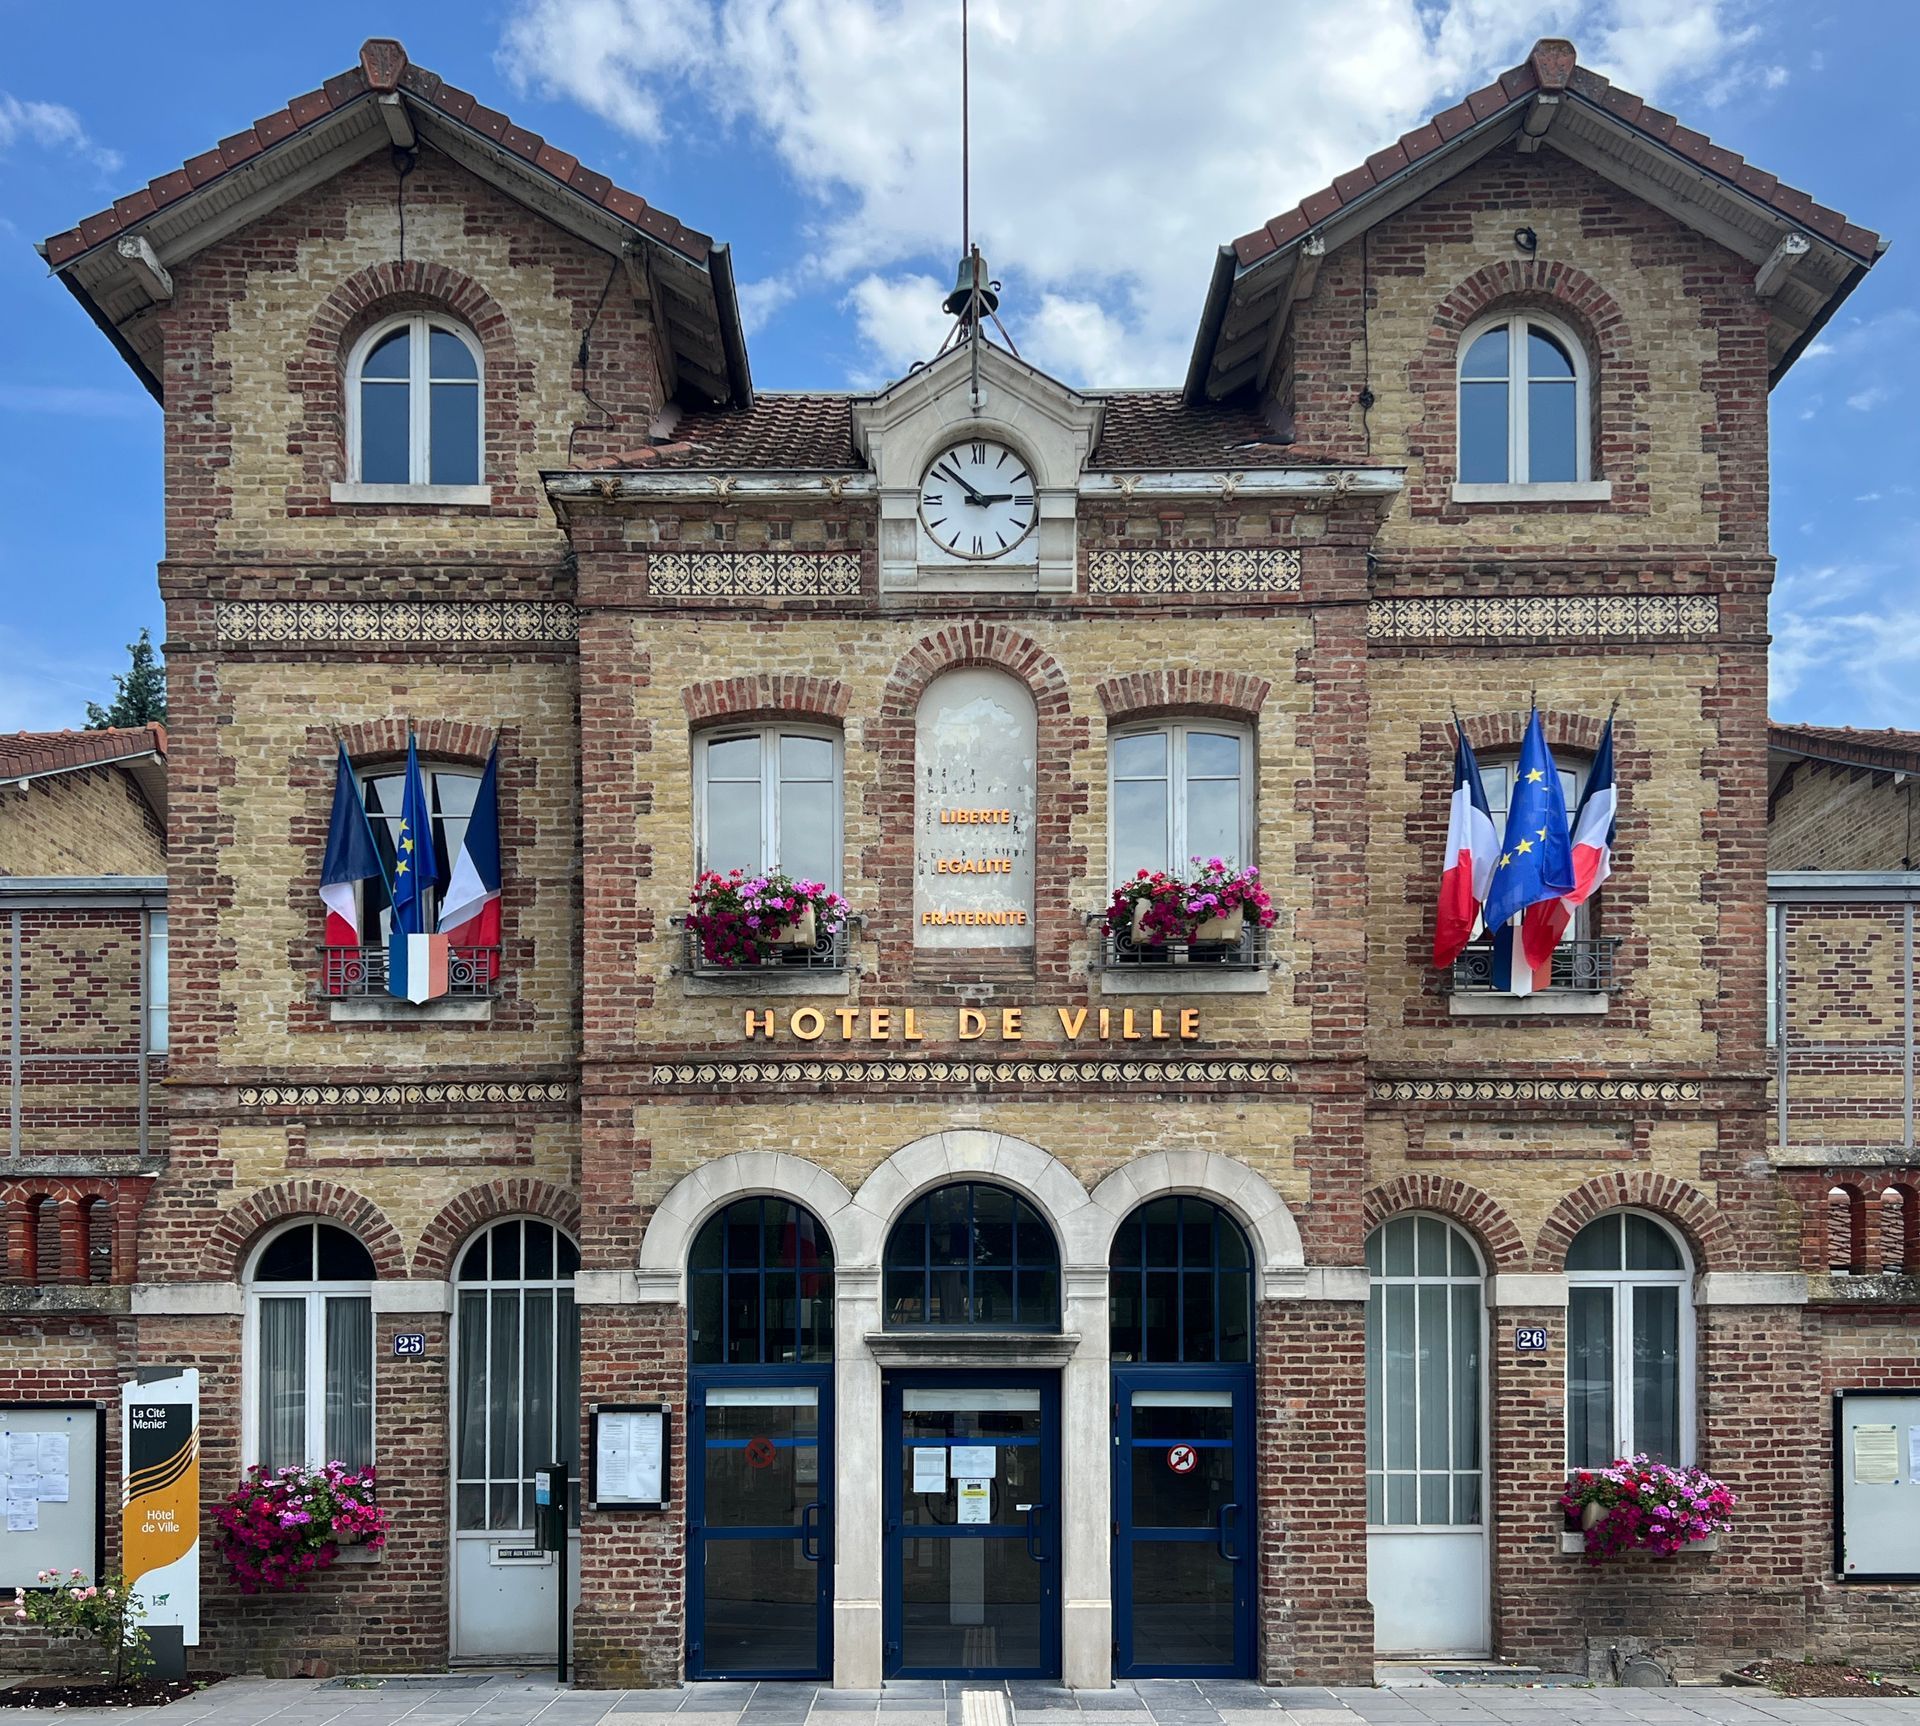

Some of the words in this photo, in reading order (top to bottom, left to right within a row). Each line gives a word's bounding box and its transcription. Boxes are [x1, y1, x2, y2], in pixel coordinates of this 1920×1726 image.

[971, 444, 986, 465] XII
[940, 808, 1010, 824] LIBERTE
[937, 859, 1011, 874] EGALITE
[922, 911, 1026, 926] FRATERNITE
[745, 1007, 923, 1040] HOTEL
[959, 1008, 1022, 1040] DE
[1057, 1008, 1199, 1040] VILLE
[398, 1336, 421, 1352] 25
[1520, 1331, 1543, 1347] 26
[132, 1408, 144, 1418] La
[146, 1407, 166, 1418] Cité
[132, 1418, 168, 1429] Menier
[147, 1508, 174, 1520] Hôtel
[141, 1521, 155, 1532] de
[157, 1521, 180, 1532] Ville
